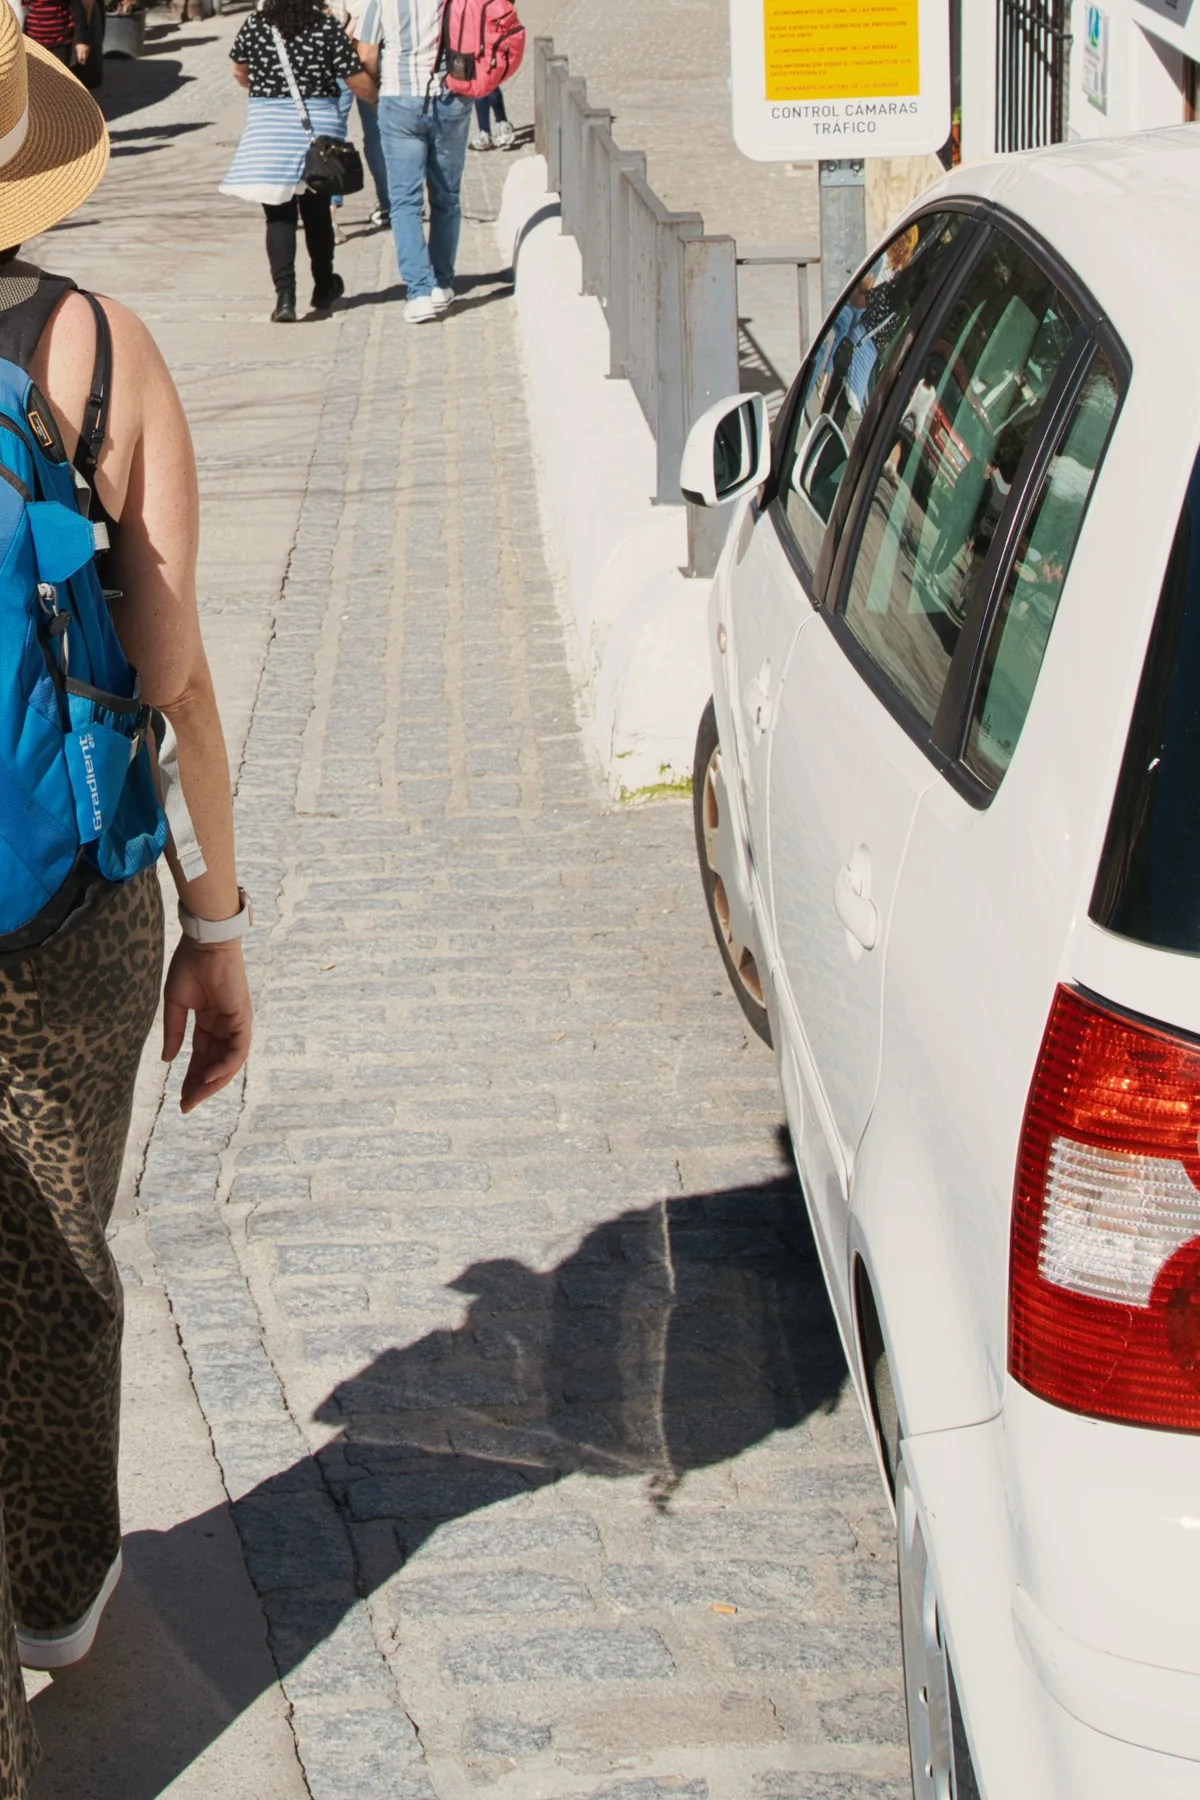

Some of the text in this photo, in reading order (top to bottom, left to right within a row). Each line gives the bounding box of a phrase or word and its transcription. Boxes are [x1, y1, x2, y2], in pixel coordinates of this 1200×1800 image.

[771, 101, 918, 119] CONTROL CÁMARAS
[814, 119, 876, 135] TRÁFICO
[80, 733, 102, 831] Gradient
